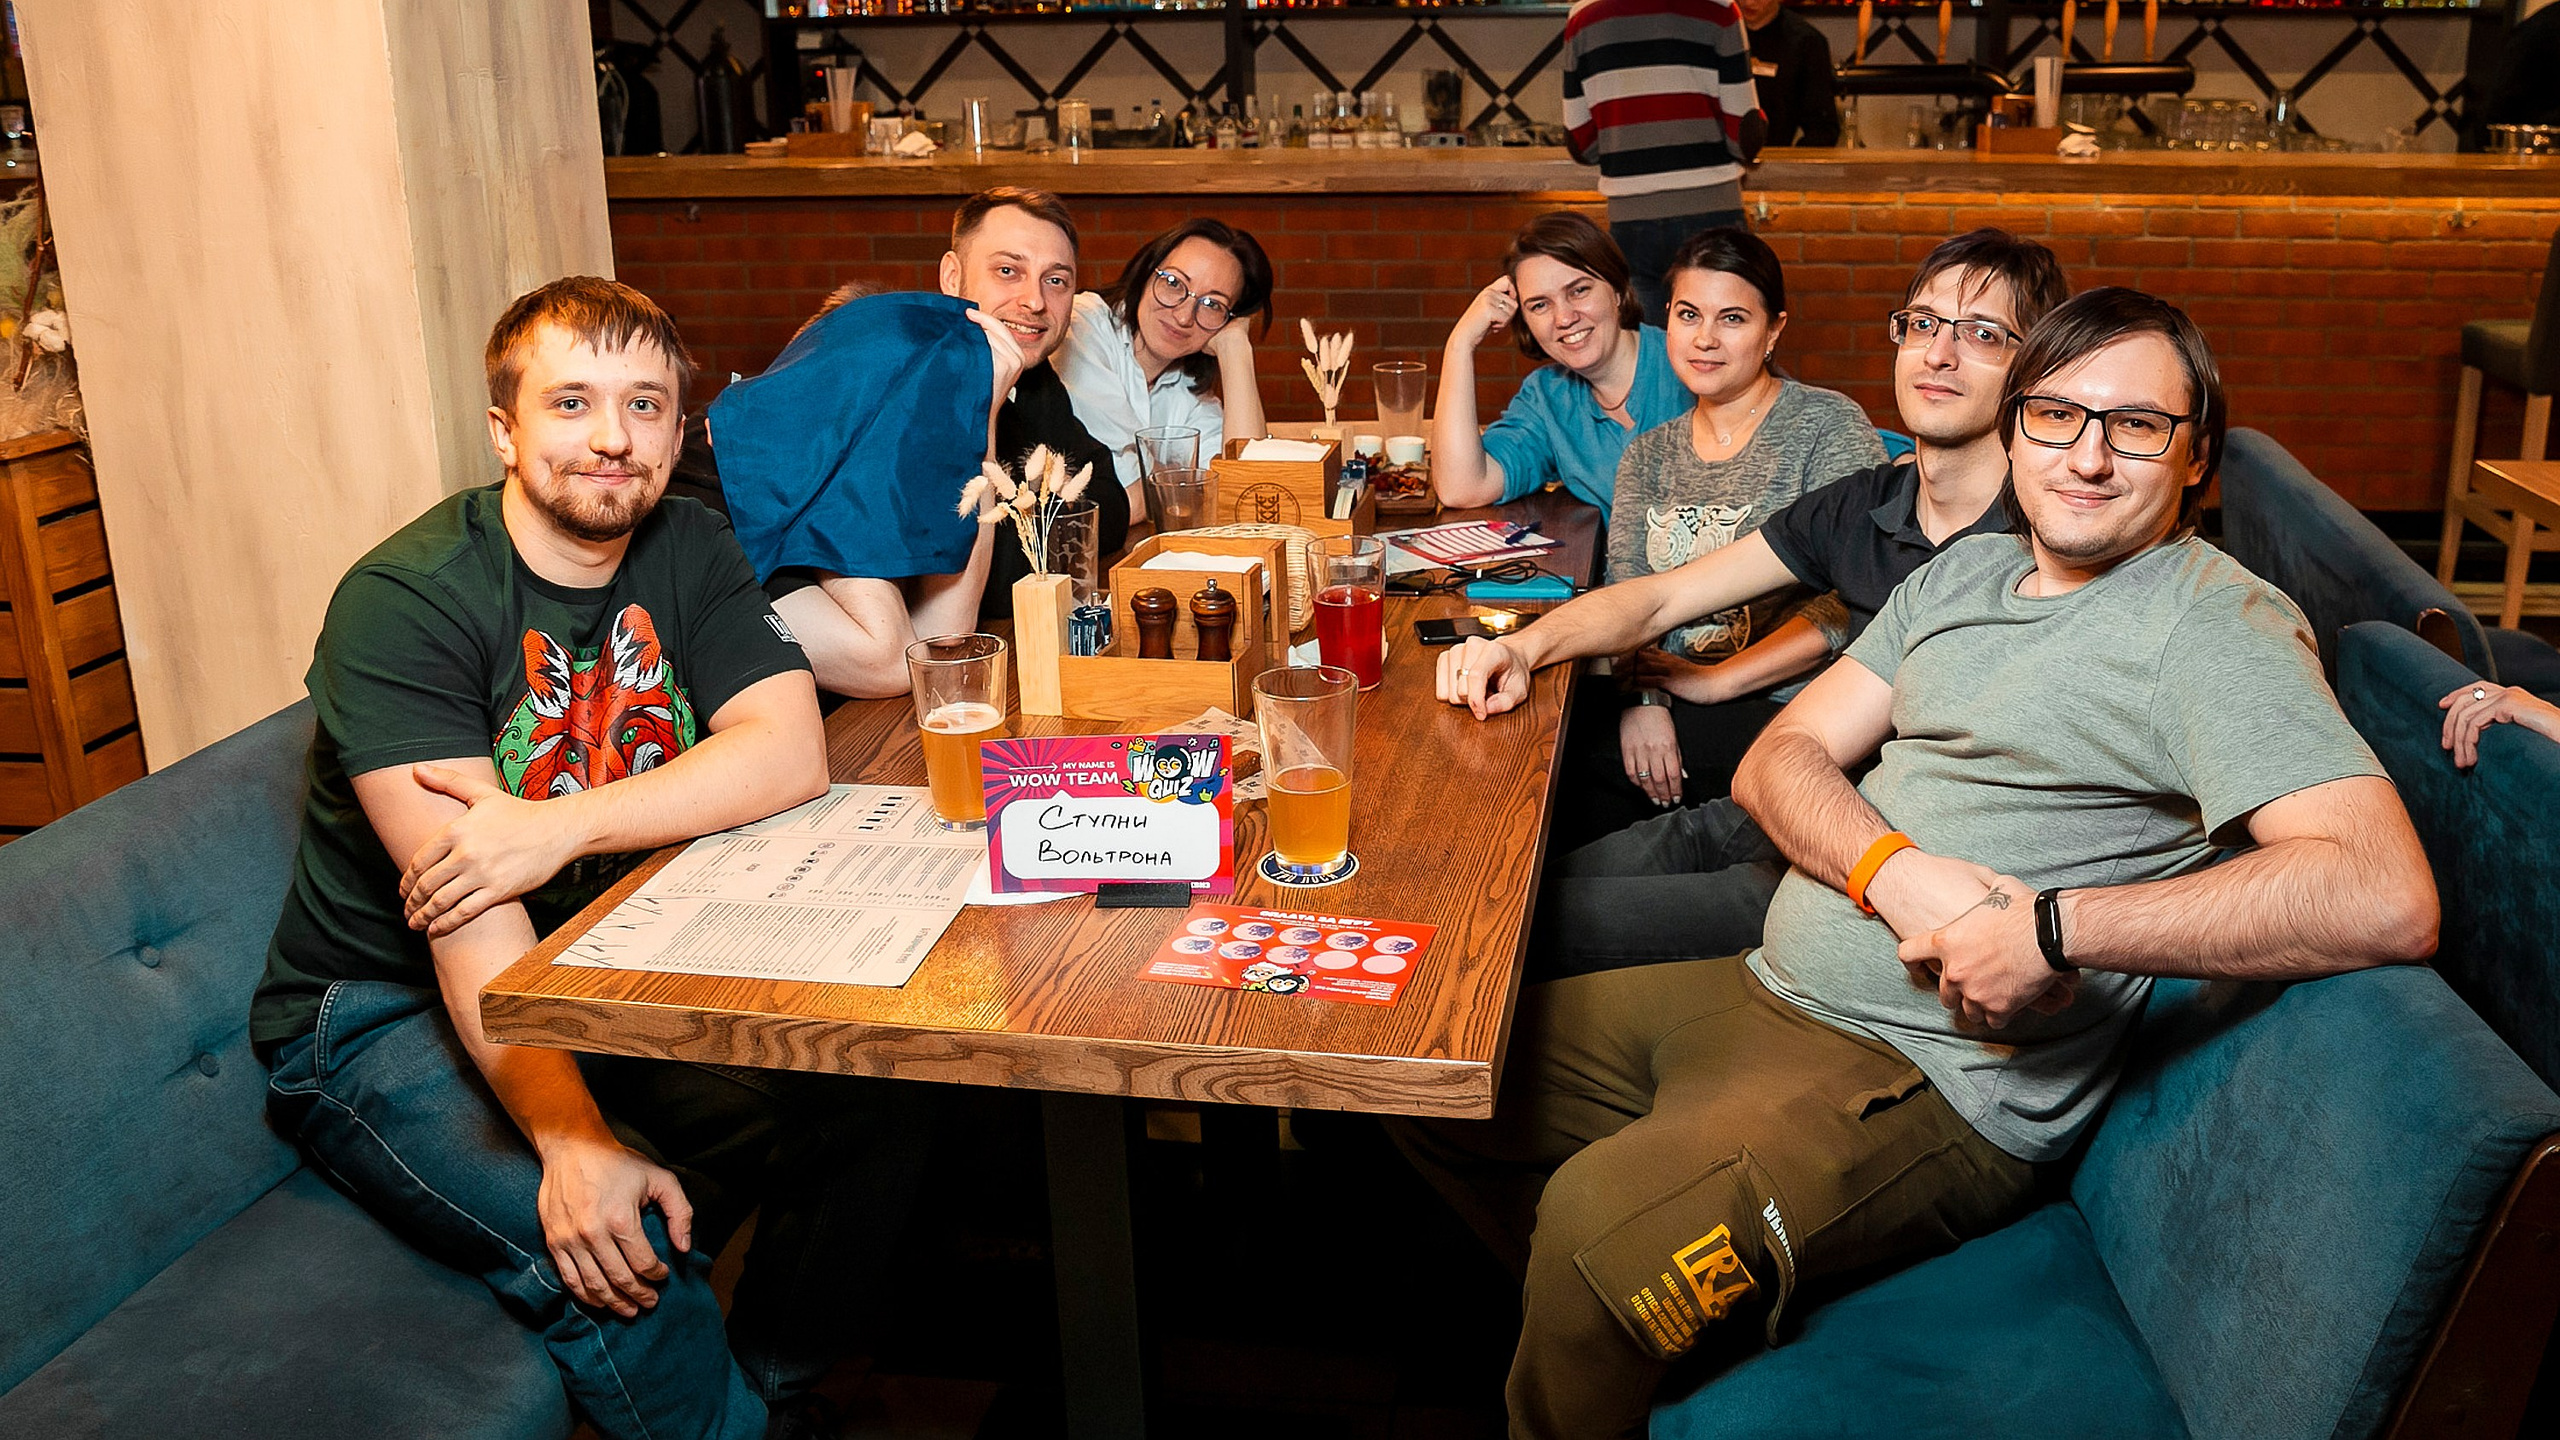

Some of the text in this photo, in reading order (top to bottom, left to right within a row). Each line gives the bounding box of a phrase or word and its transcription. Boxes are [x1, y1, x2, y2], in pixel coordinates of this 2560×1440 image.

[1062, 761, 1116, 770] MY NAME IS
[1008, 771, 1119, 788] WOW TEAM
[1148, 776, 1195, 799] QUIZ
